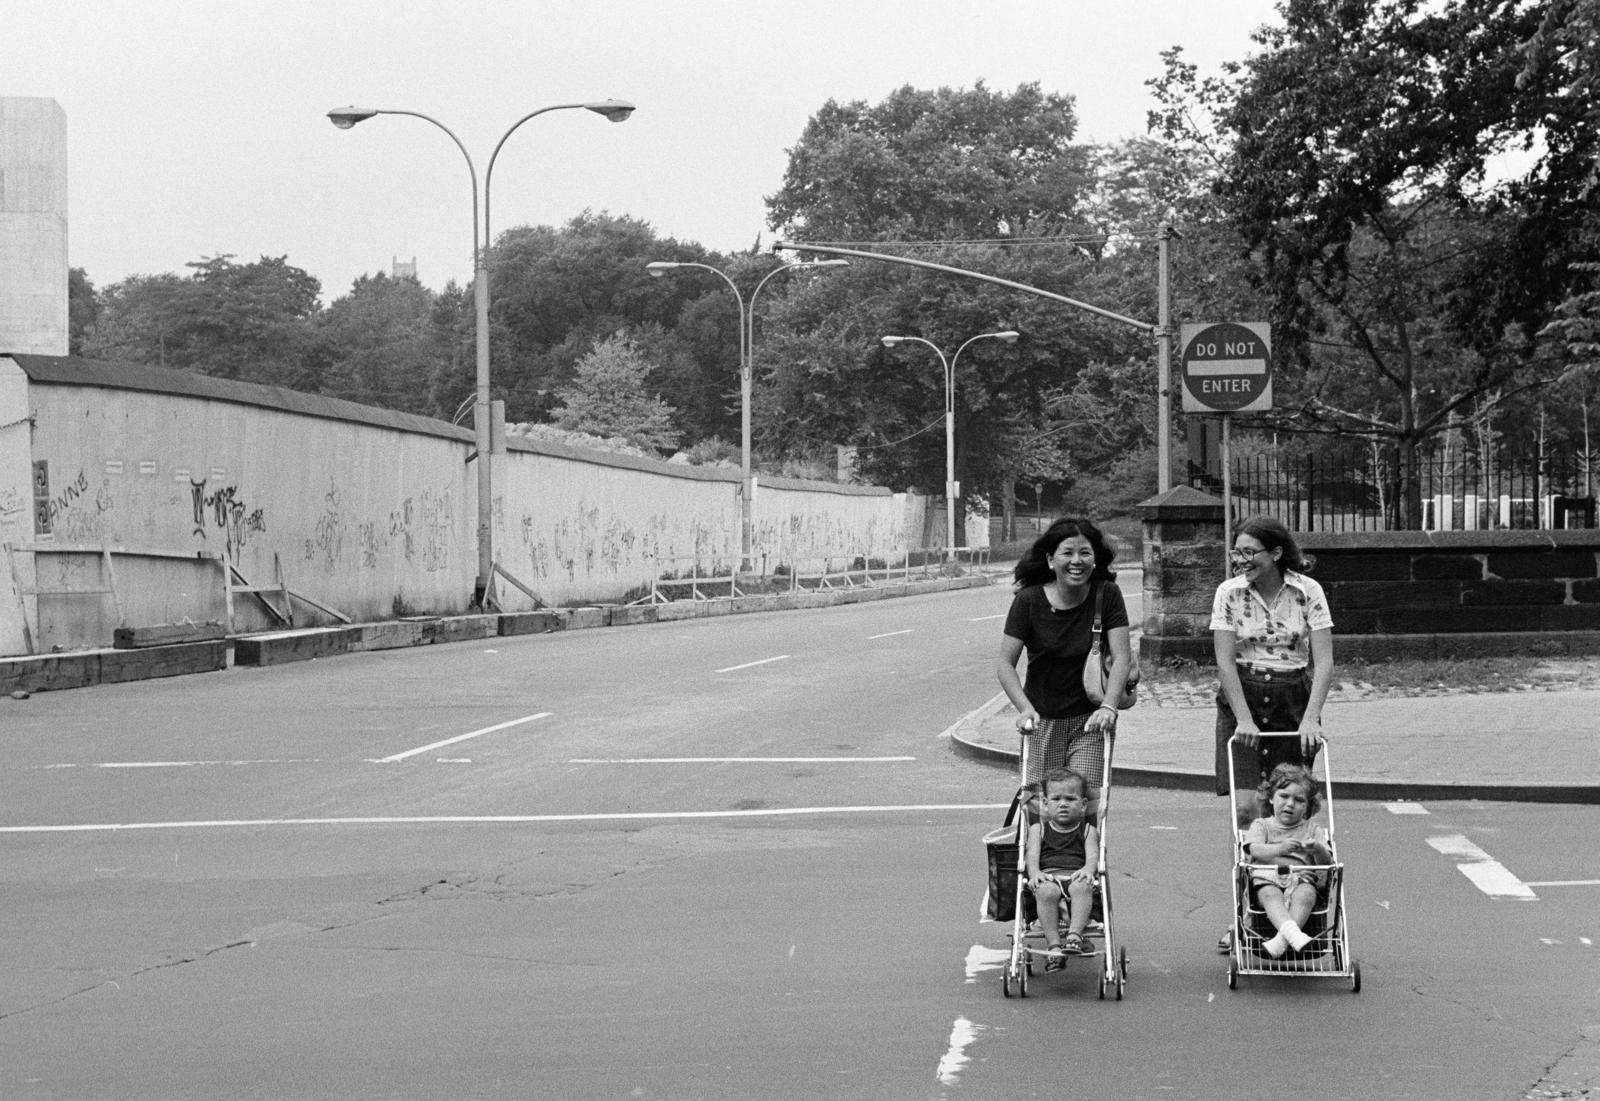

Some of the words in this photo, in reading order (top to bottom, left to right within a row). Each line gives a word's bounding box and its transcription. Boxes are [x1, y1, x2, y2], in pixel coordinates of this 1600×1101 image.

[1196, 343, 1217, 357] DO
[1225, 342, 1256, 356] NOT
[1202, 379, 1251, 393] ENTER
[49, 468, 88, 528] ANNE
